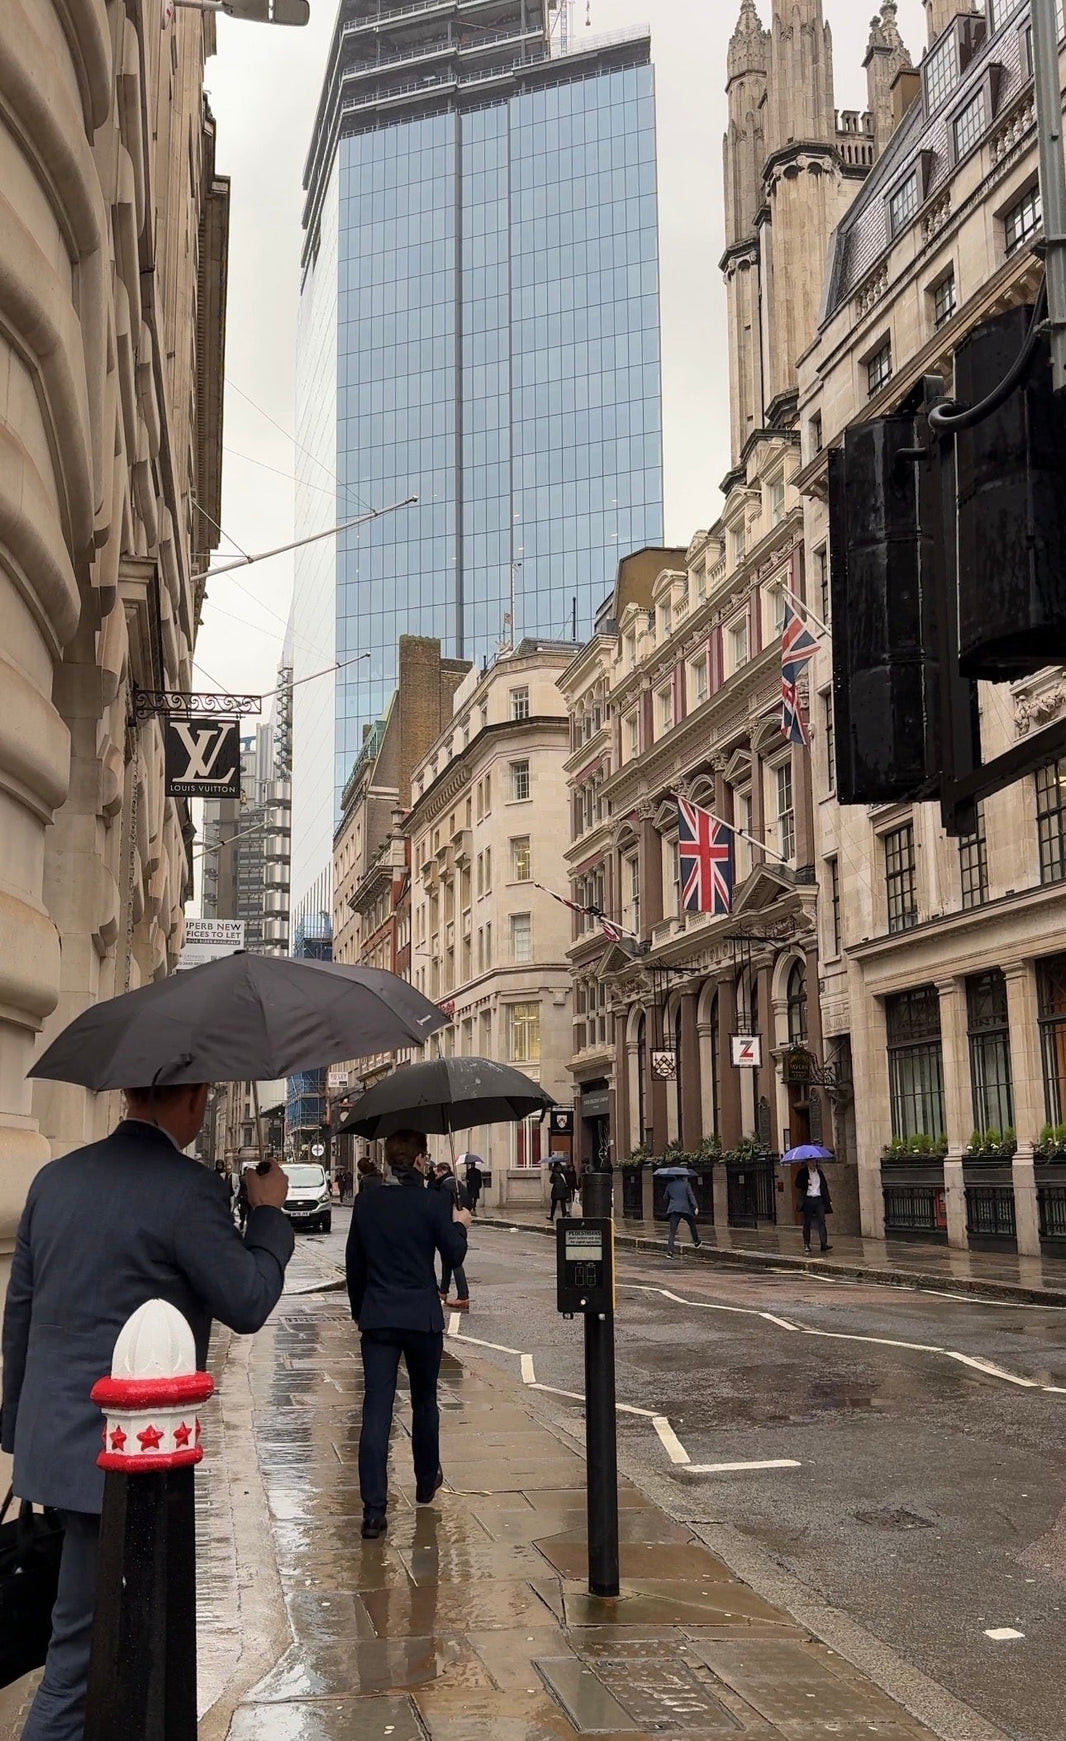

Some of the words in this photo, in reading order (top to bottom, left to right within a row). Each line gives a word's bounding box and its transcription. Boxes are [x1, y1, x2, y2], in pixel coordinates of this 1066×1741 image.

[170, 784, 196, 792] LOUIS
[198, 785, 236, 793] VUITTON
[186, 922, 213, 930] PERB
[217, 923, 241, 931] NEW
[740, 1040, 753, 1057] Z
